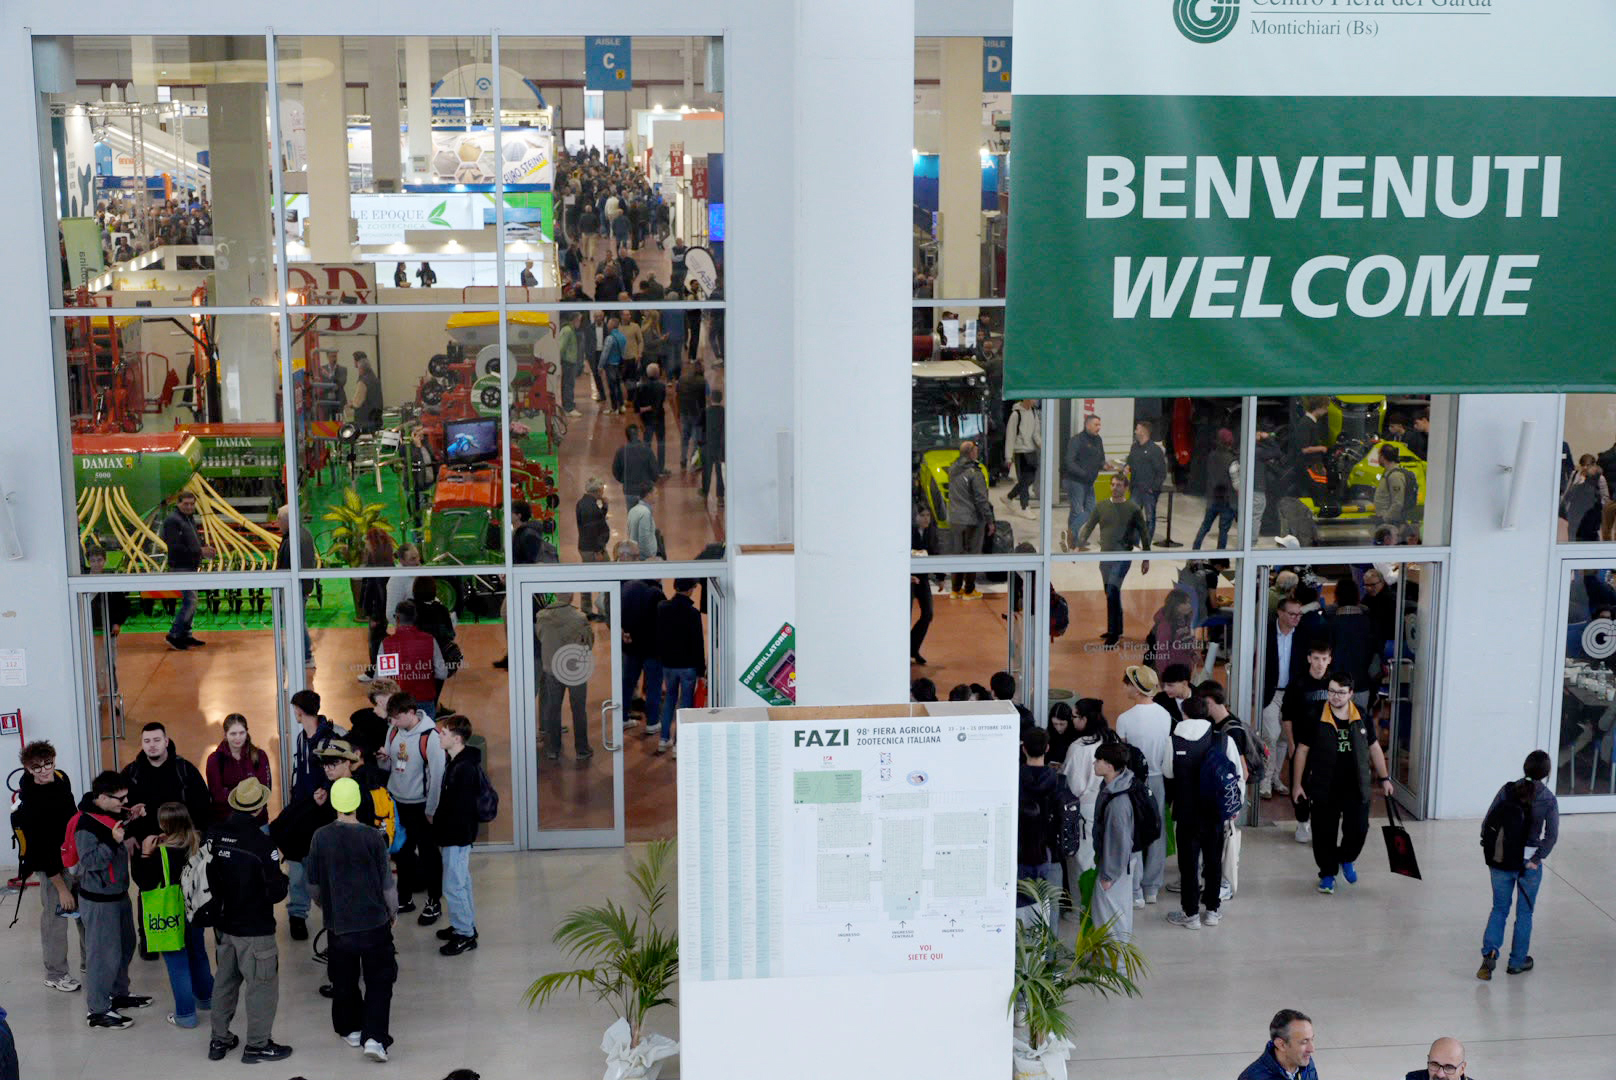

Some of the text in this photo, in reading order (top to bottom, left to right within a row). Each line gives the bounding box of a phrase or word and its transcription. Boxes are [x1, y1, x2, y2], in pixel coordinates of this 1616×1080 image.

[1250, 19, 1379, 38] Montichiari (Bs)
[594, 38, 622, 46] AISLE
[602, 52, 616, 70] C
[987, 55, 1003, 73] D
[1085, 154, 1562, 219] BENVENUTI
[372, 209, 424, 222] EPOQUE
[1112, 254, 1540, 318] WELCOME
[215, 437, 252, 448] DAMAX
[82, 457, 124, 470] DAMAX
[1123, 641, 1150, 651] Fiera
[1153, 639, 1169, 651] del
[873, 726, 896, 735] FIERA
[900, 725, 941, 734] AGRICOLA
[794, 728, 849, 748] FAZI
[857, 735, 941, 746] ZOOTECNICA ITALIANA
[148, 913, 181, 931] laber
[919, 944, 932, 952] VOI
[908, 952, 944, 961] SIETE QUI
